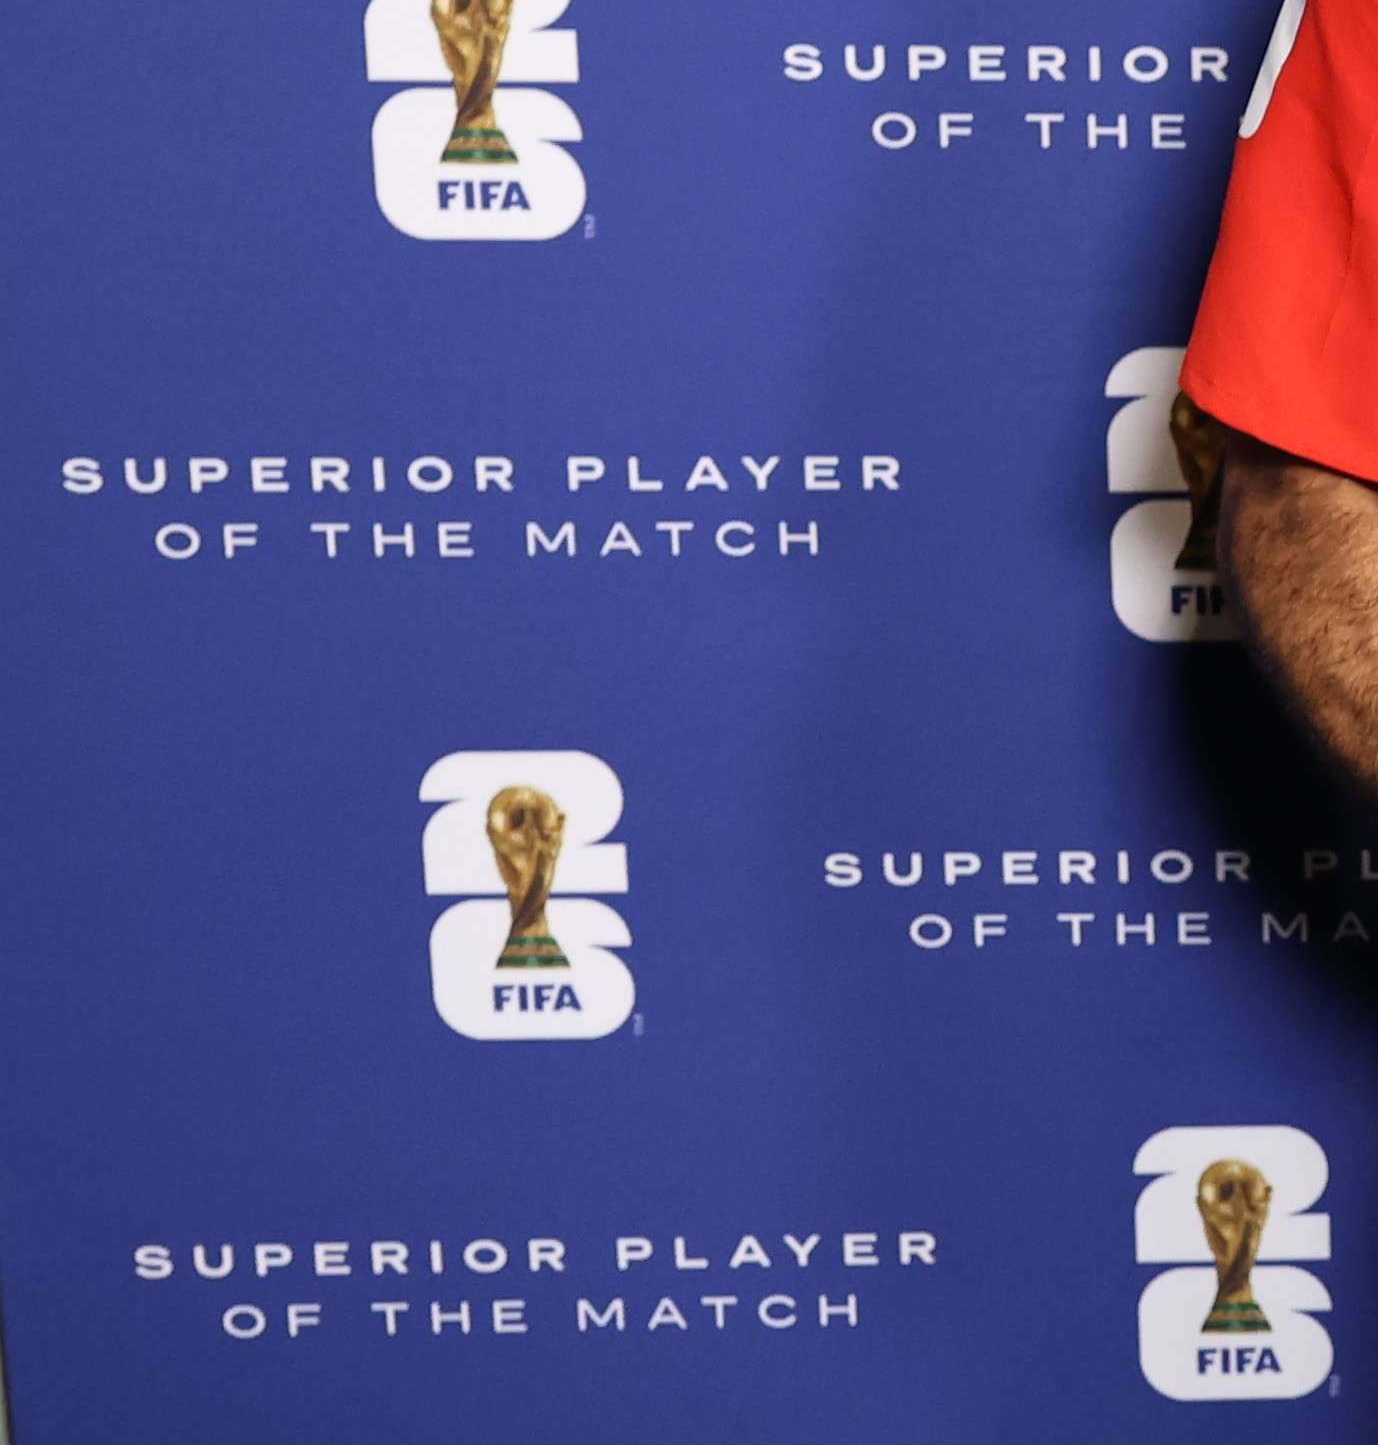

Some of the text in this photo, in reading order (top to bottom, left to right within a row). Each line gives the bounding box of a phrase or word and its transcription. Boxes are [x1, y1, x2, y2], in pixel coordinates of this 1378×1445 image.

[781, 42, 1230, 85] SUPERIOR
[870, 110, 1188, 151] OF THE
[436, 179, 531, 211] FIFA
[60, 453, 902, 496] SUPERIOR PLAYER
[153, 518, 820, 561] OF THE MATCH
[822, 848, 1250, 889] SUPERIOR
[907, 912, 1010, 951] OF
[1054, 910, 1213, 948] THE
[492, 983, 583, 1013] FIFA
[132, 1230, 938, 1281] SUPERIOR PLAYER
[221, 1292, 859, 1341] OF THE MATCH
[1196, 1345, 1283, 1376] FIFA
